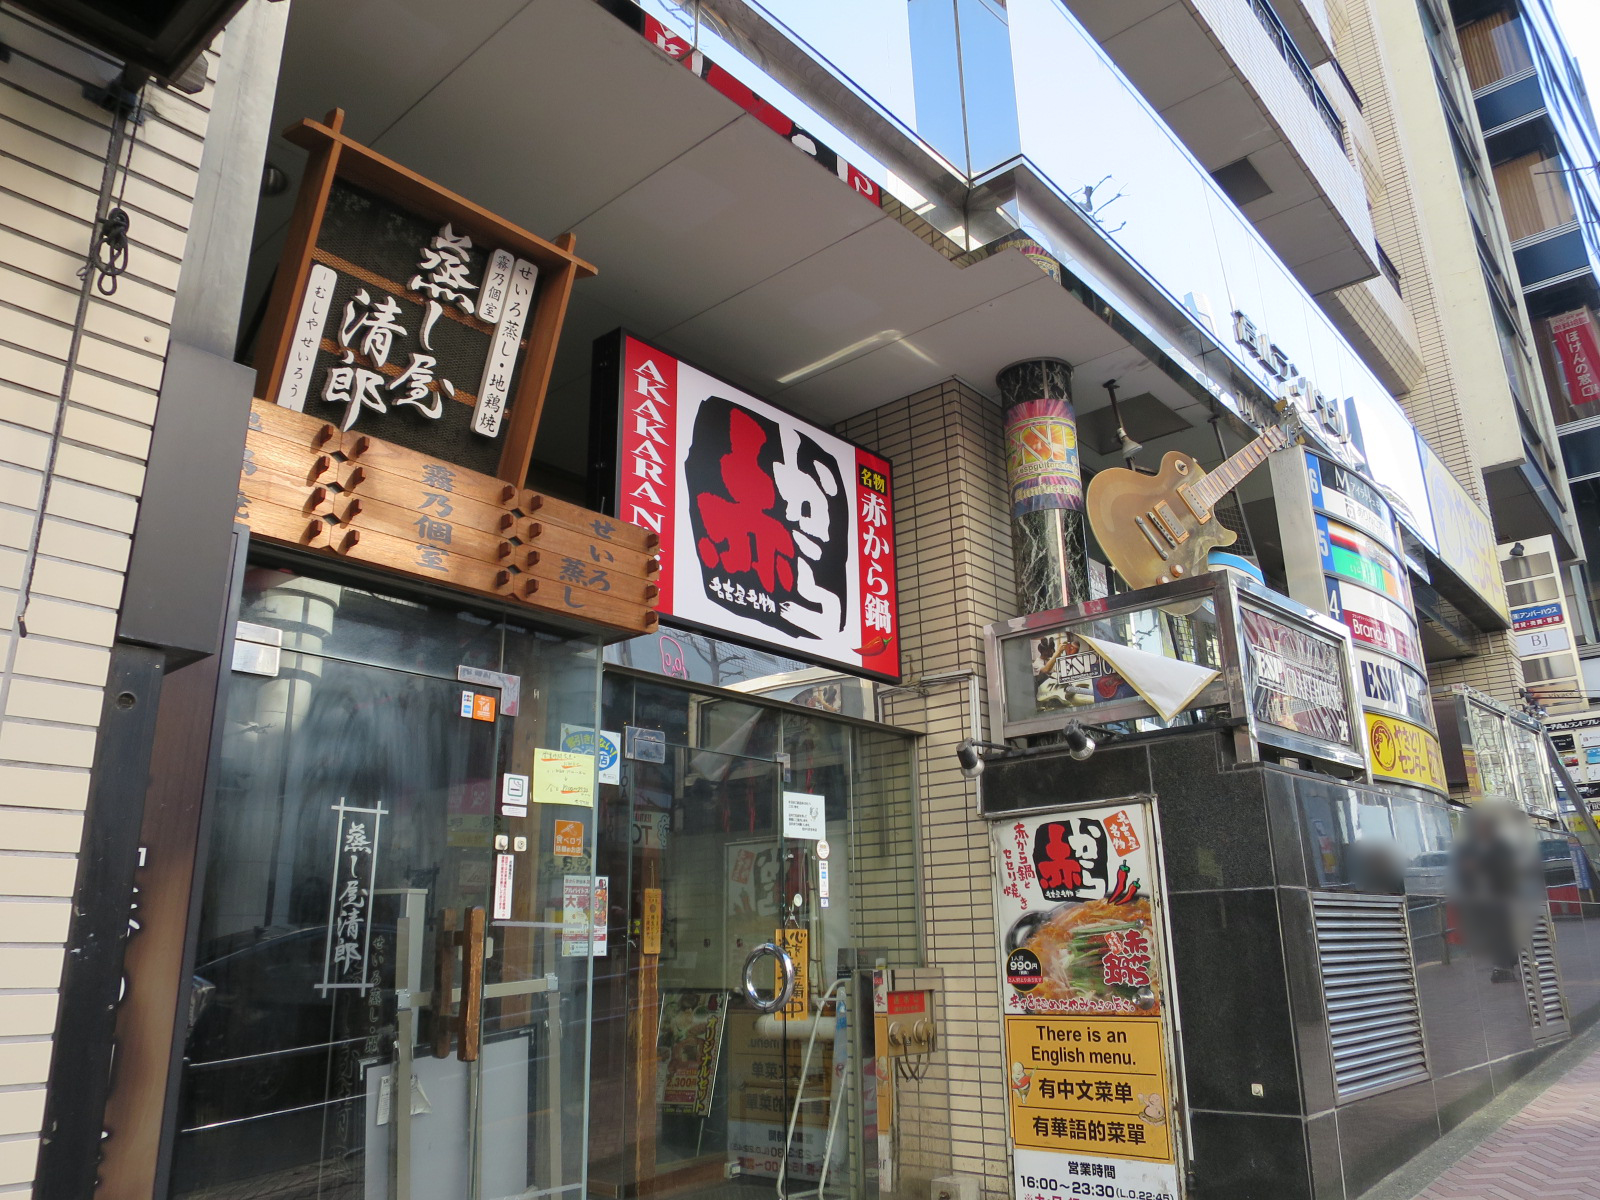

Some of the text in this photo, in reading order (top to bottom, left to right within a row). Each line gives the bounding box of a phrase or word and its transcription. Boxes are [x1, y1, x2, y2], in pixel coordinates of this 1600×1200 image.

[482, 254, 510, 318] 霧乃個室
[386, 222, 480, 420] 蒸し屋
[321, 288, 408, 433] 清郎
[480, 266, 533, 433] せいろ蒸し・地鶏焼
[1566, 331, 1593, 397] ほけんの窓口
[860, 467, 886, 493] 名物
[1308, 468, 1319, 494] 6
[413, 463, 458, 573] 霧乃個室
[588, 518, 615, 592] せいろ
[1318, 530, 1329, 557] 5
[860, 492, 893, 634] 赤から鍋
[559, 556, 593, 610] 蒸し
[708, 576, 776, 613] 名古屋名物
[1329, 590, 1340, 620] 4
[1060, 653, 1097, 677] ESP
[1393, 724, 1423, 754] やきとり
[1398, 749, 1426, 778] センター
[1014, 822, 1035, 889] 赤から鍋と
[1038, 822, 1106, 900] 赤から
[1003, 848, 1038, 910] セセリ焼き
[334, 821, 372, 975] 蒸し屋清郎
[1010, 961, 1038, 971] 990円
[1036, 1025, 1127, 1043] There is an
[1031, 1045, 1136, 1066] English menu.
[1038, 1077, 1133, 1104] 有中文菜单
[1032, 1115, 1147, 1146] 有華語的菜單
[1067, 1160, 1116, 1180] 営業時間
